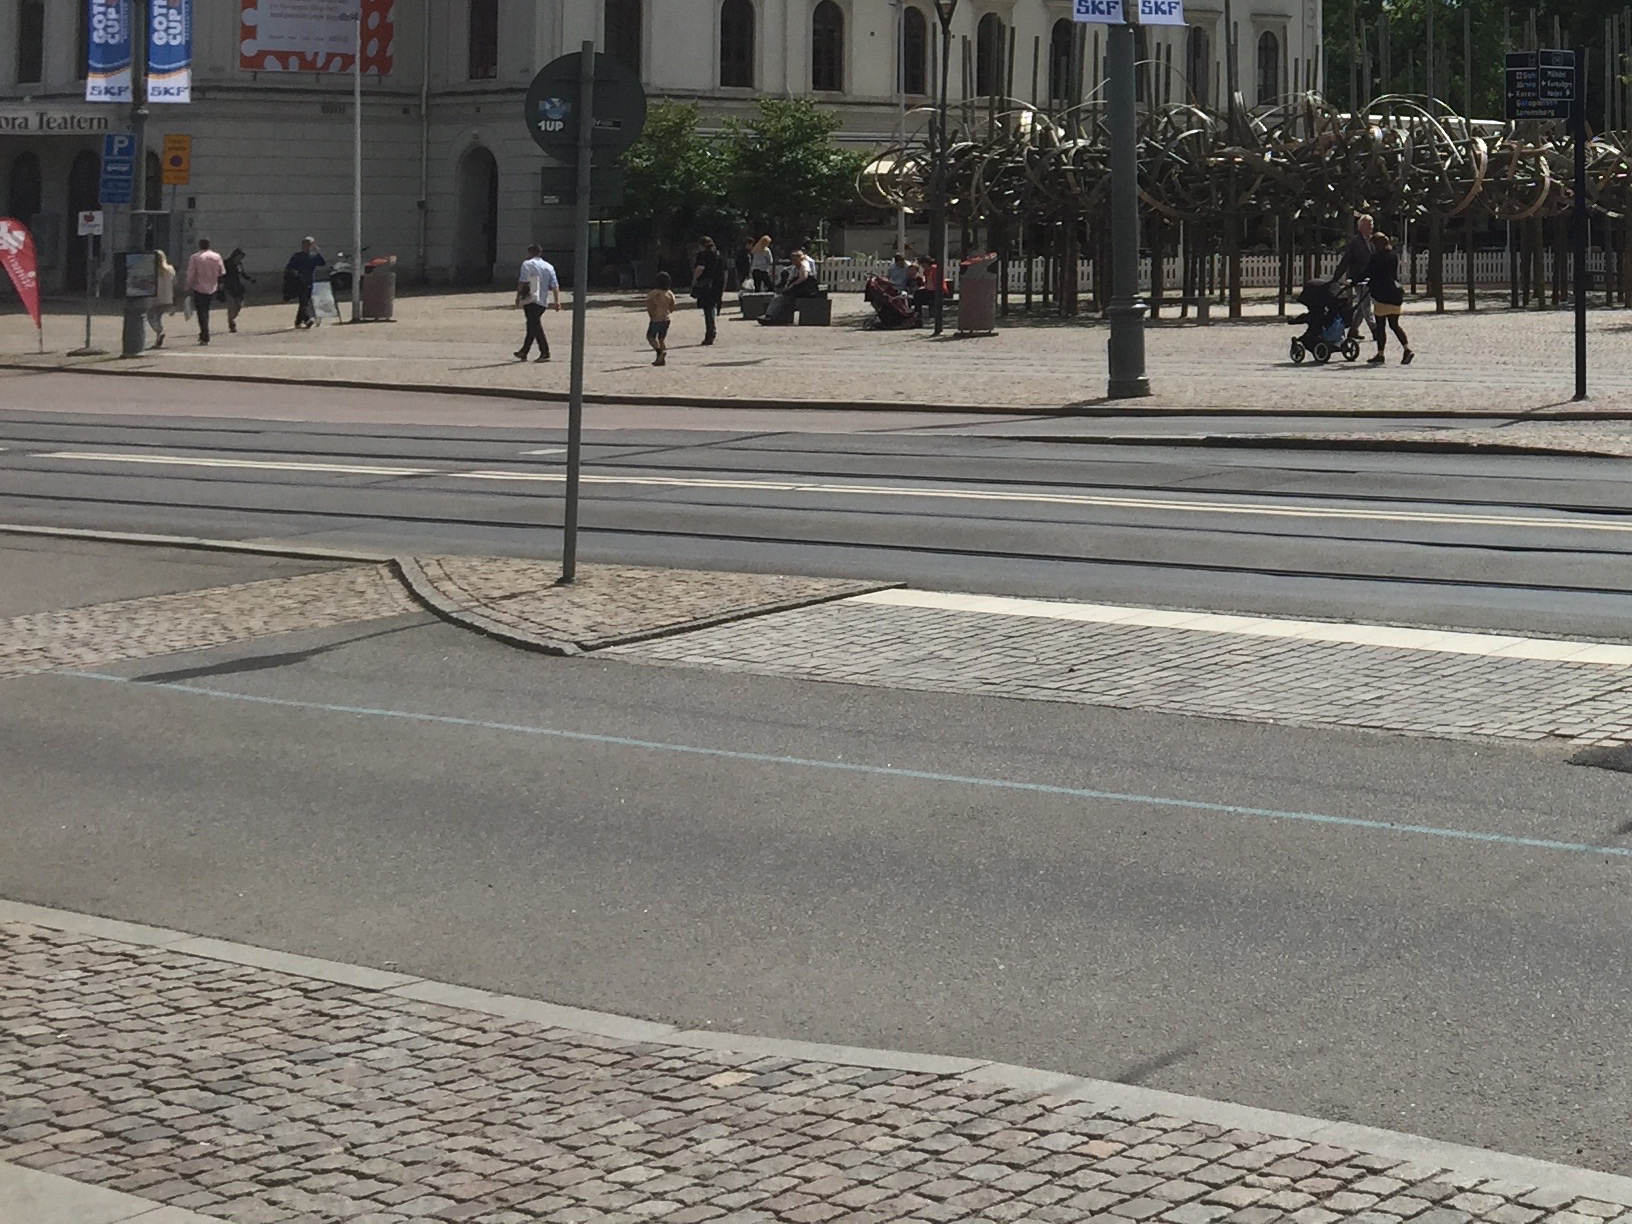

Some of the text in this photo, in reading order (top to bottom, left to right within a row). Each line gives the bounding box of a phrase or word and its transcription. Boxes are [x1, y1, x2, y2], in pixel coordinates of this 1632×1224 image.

[1076, 0, 1120, 16] SKF
[1140, 0, 1180, 16] SKF
[106, 7, 120, 45] CUP
[167, 8, 182, 46] CUP
[89, 84, 130, 97] SKF
[149, 85, 189, 97] SKF
[36, 111, 109, 130] Teatern
[538, 120, 564, 132] 1UP
[112, 136, 129, 155] P
